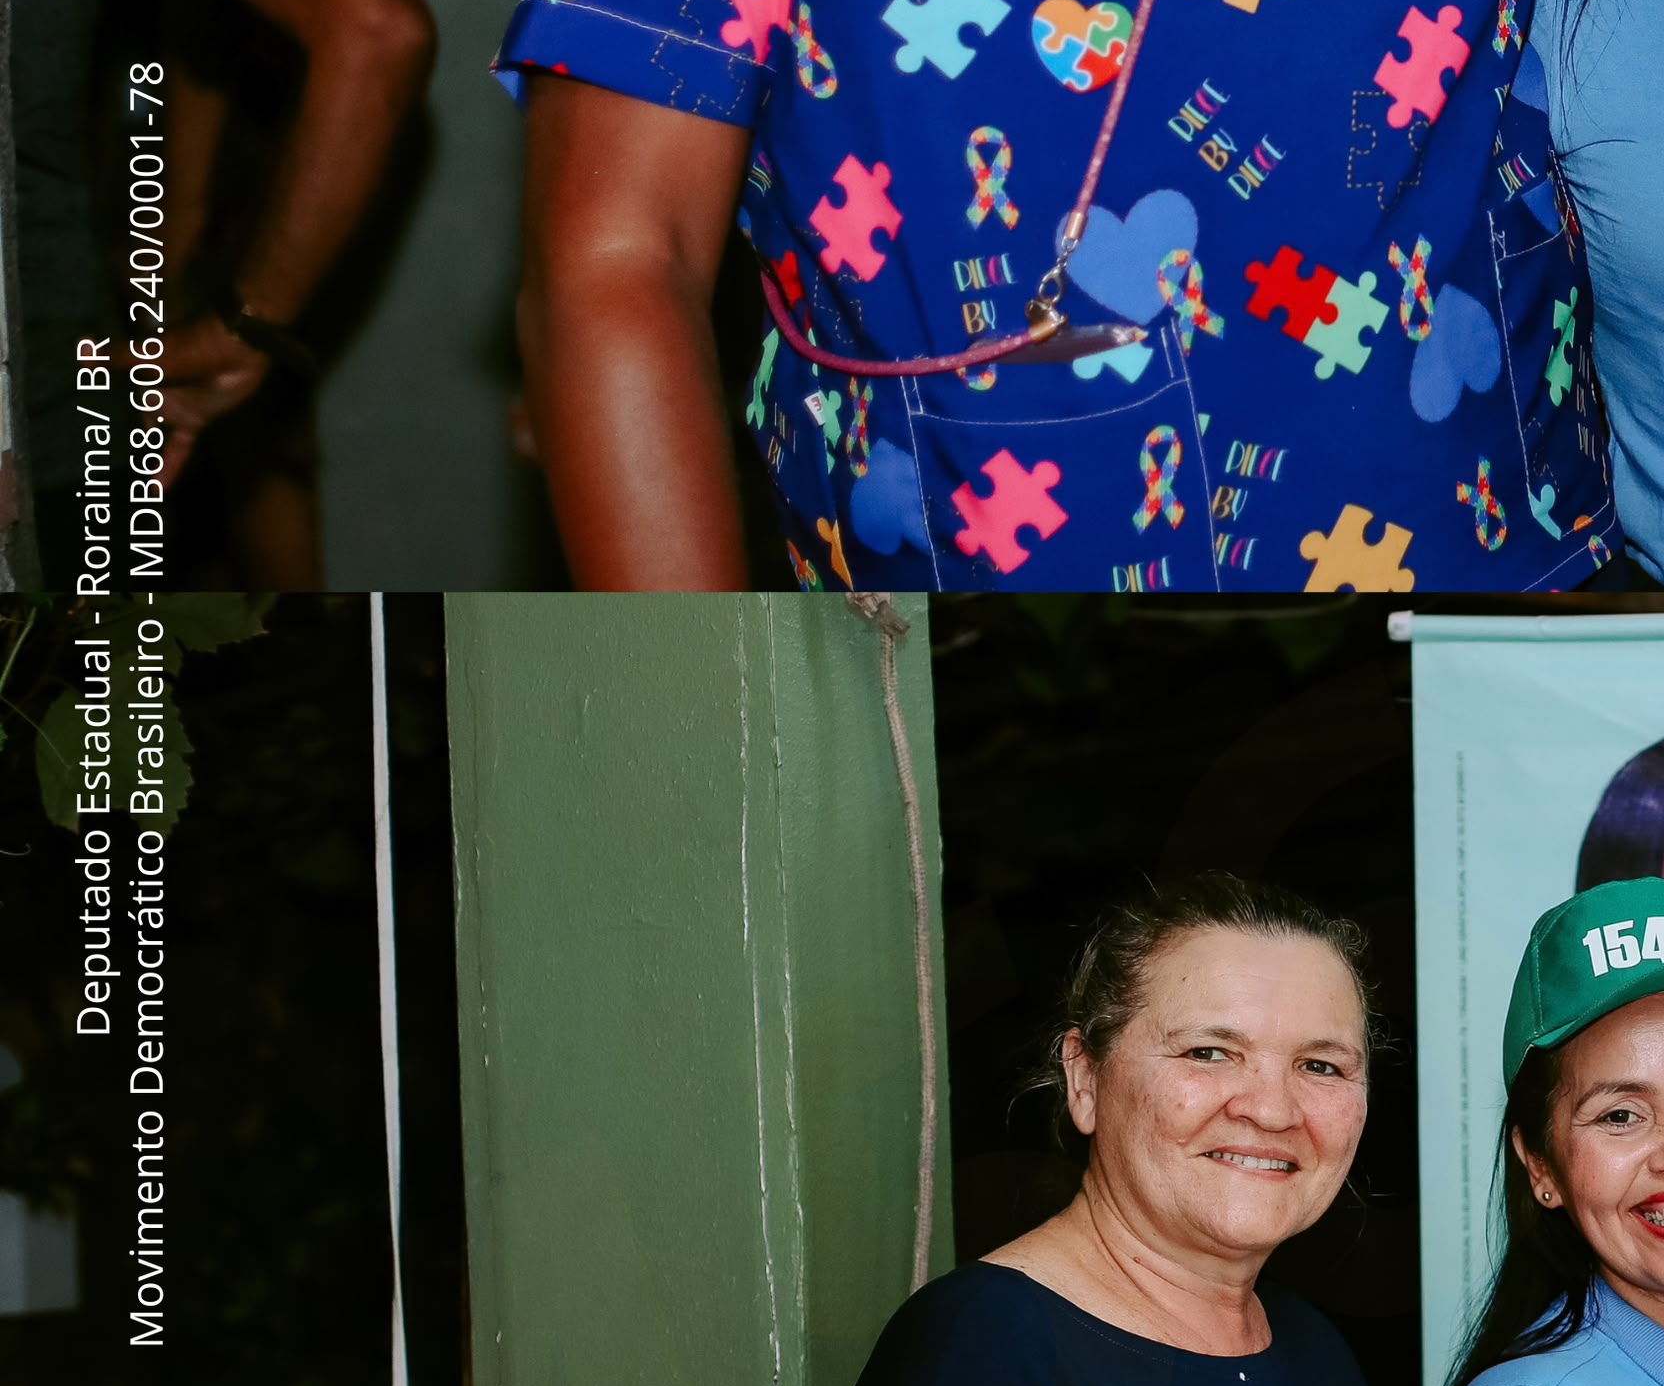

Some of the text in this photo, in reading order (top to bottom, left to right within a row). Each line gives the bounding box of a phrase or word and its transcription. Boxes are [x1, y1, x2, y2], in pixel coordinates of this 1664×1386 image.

[1168, 77, 1231, 142] PIECE
[1198, 127, 1239, 172] BY
[1227, 133, 1287, 200] PIECE
[953, 252, 1018, 292] PIECE
[962, 299, 996, 334] BY
[1225, 440, 1290, 482] PIECE
[1211, 485, 1248, 522] BY
[1215, 532, 1260, 571] IECE
